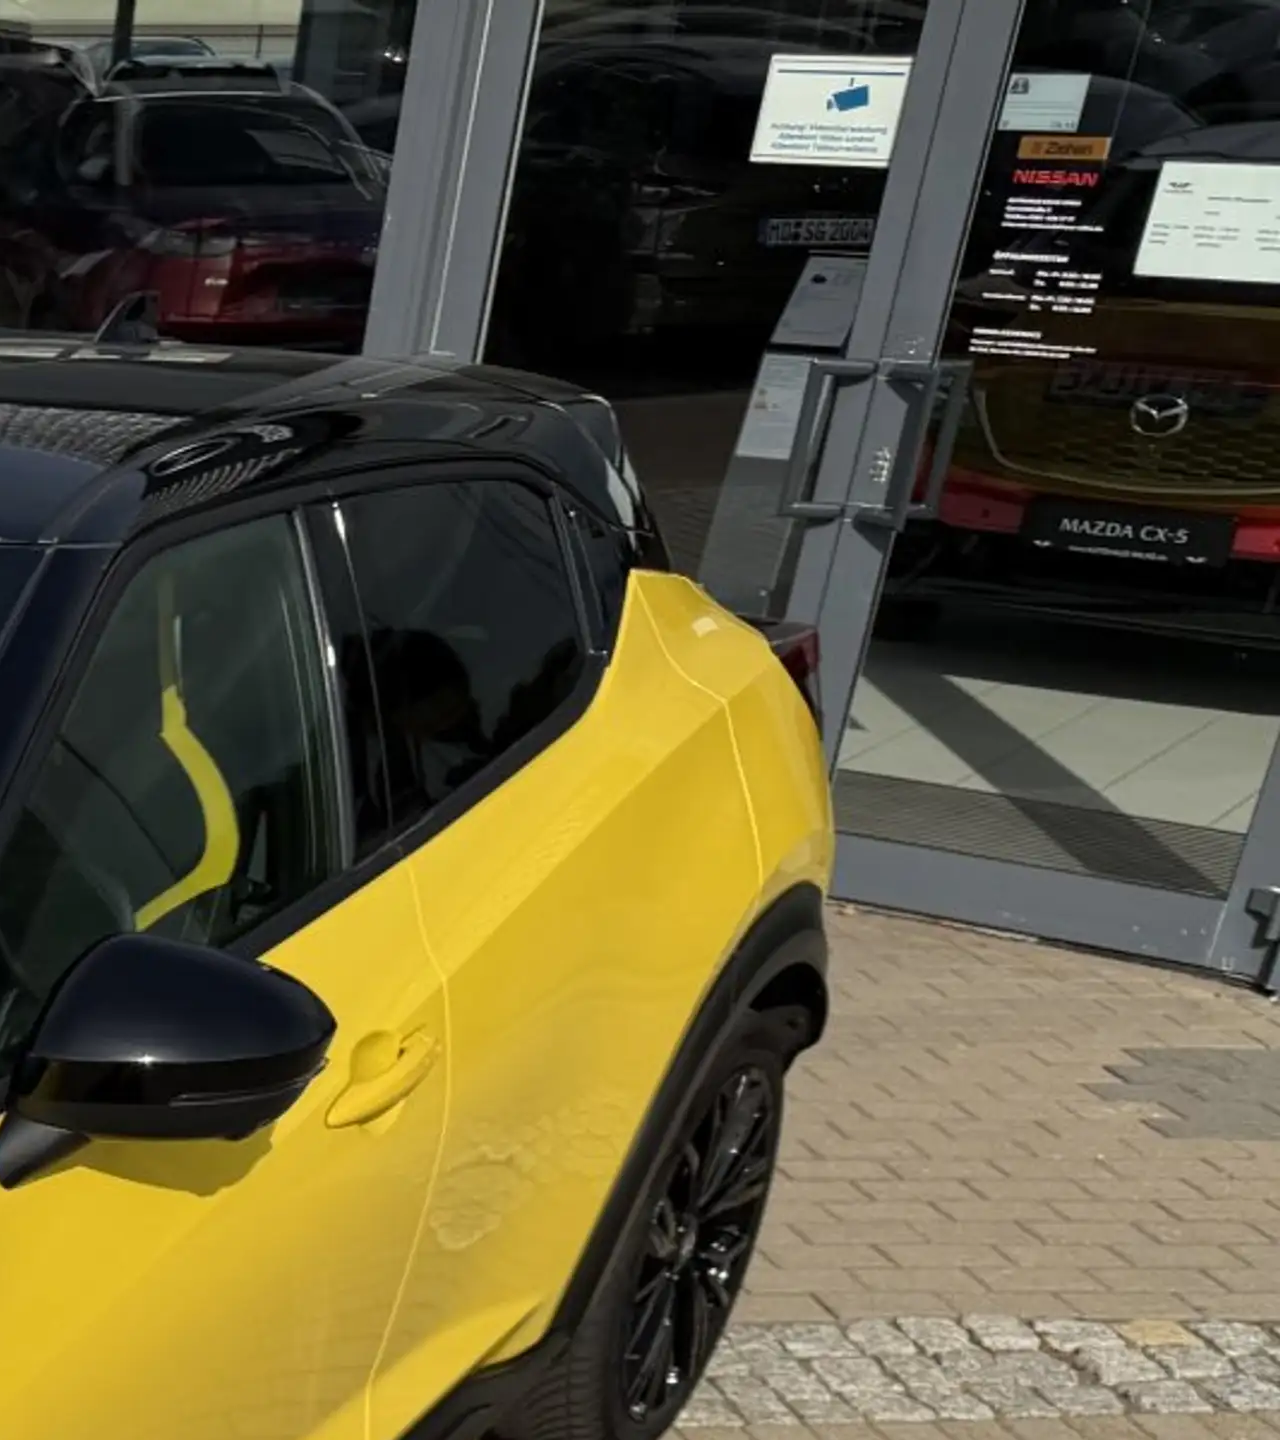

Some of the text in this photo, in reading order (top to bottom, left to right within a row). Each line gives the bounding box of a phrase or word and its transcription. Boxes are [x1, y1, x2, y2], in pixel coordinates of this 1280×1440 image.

[1012, 169, 1100, 188] NISSAN
[1058, 517, 1190, 544] MAZDA CX-5
